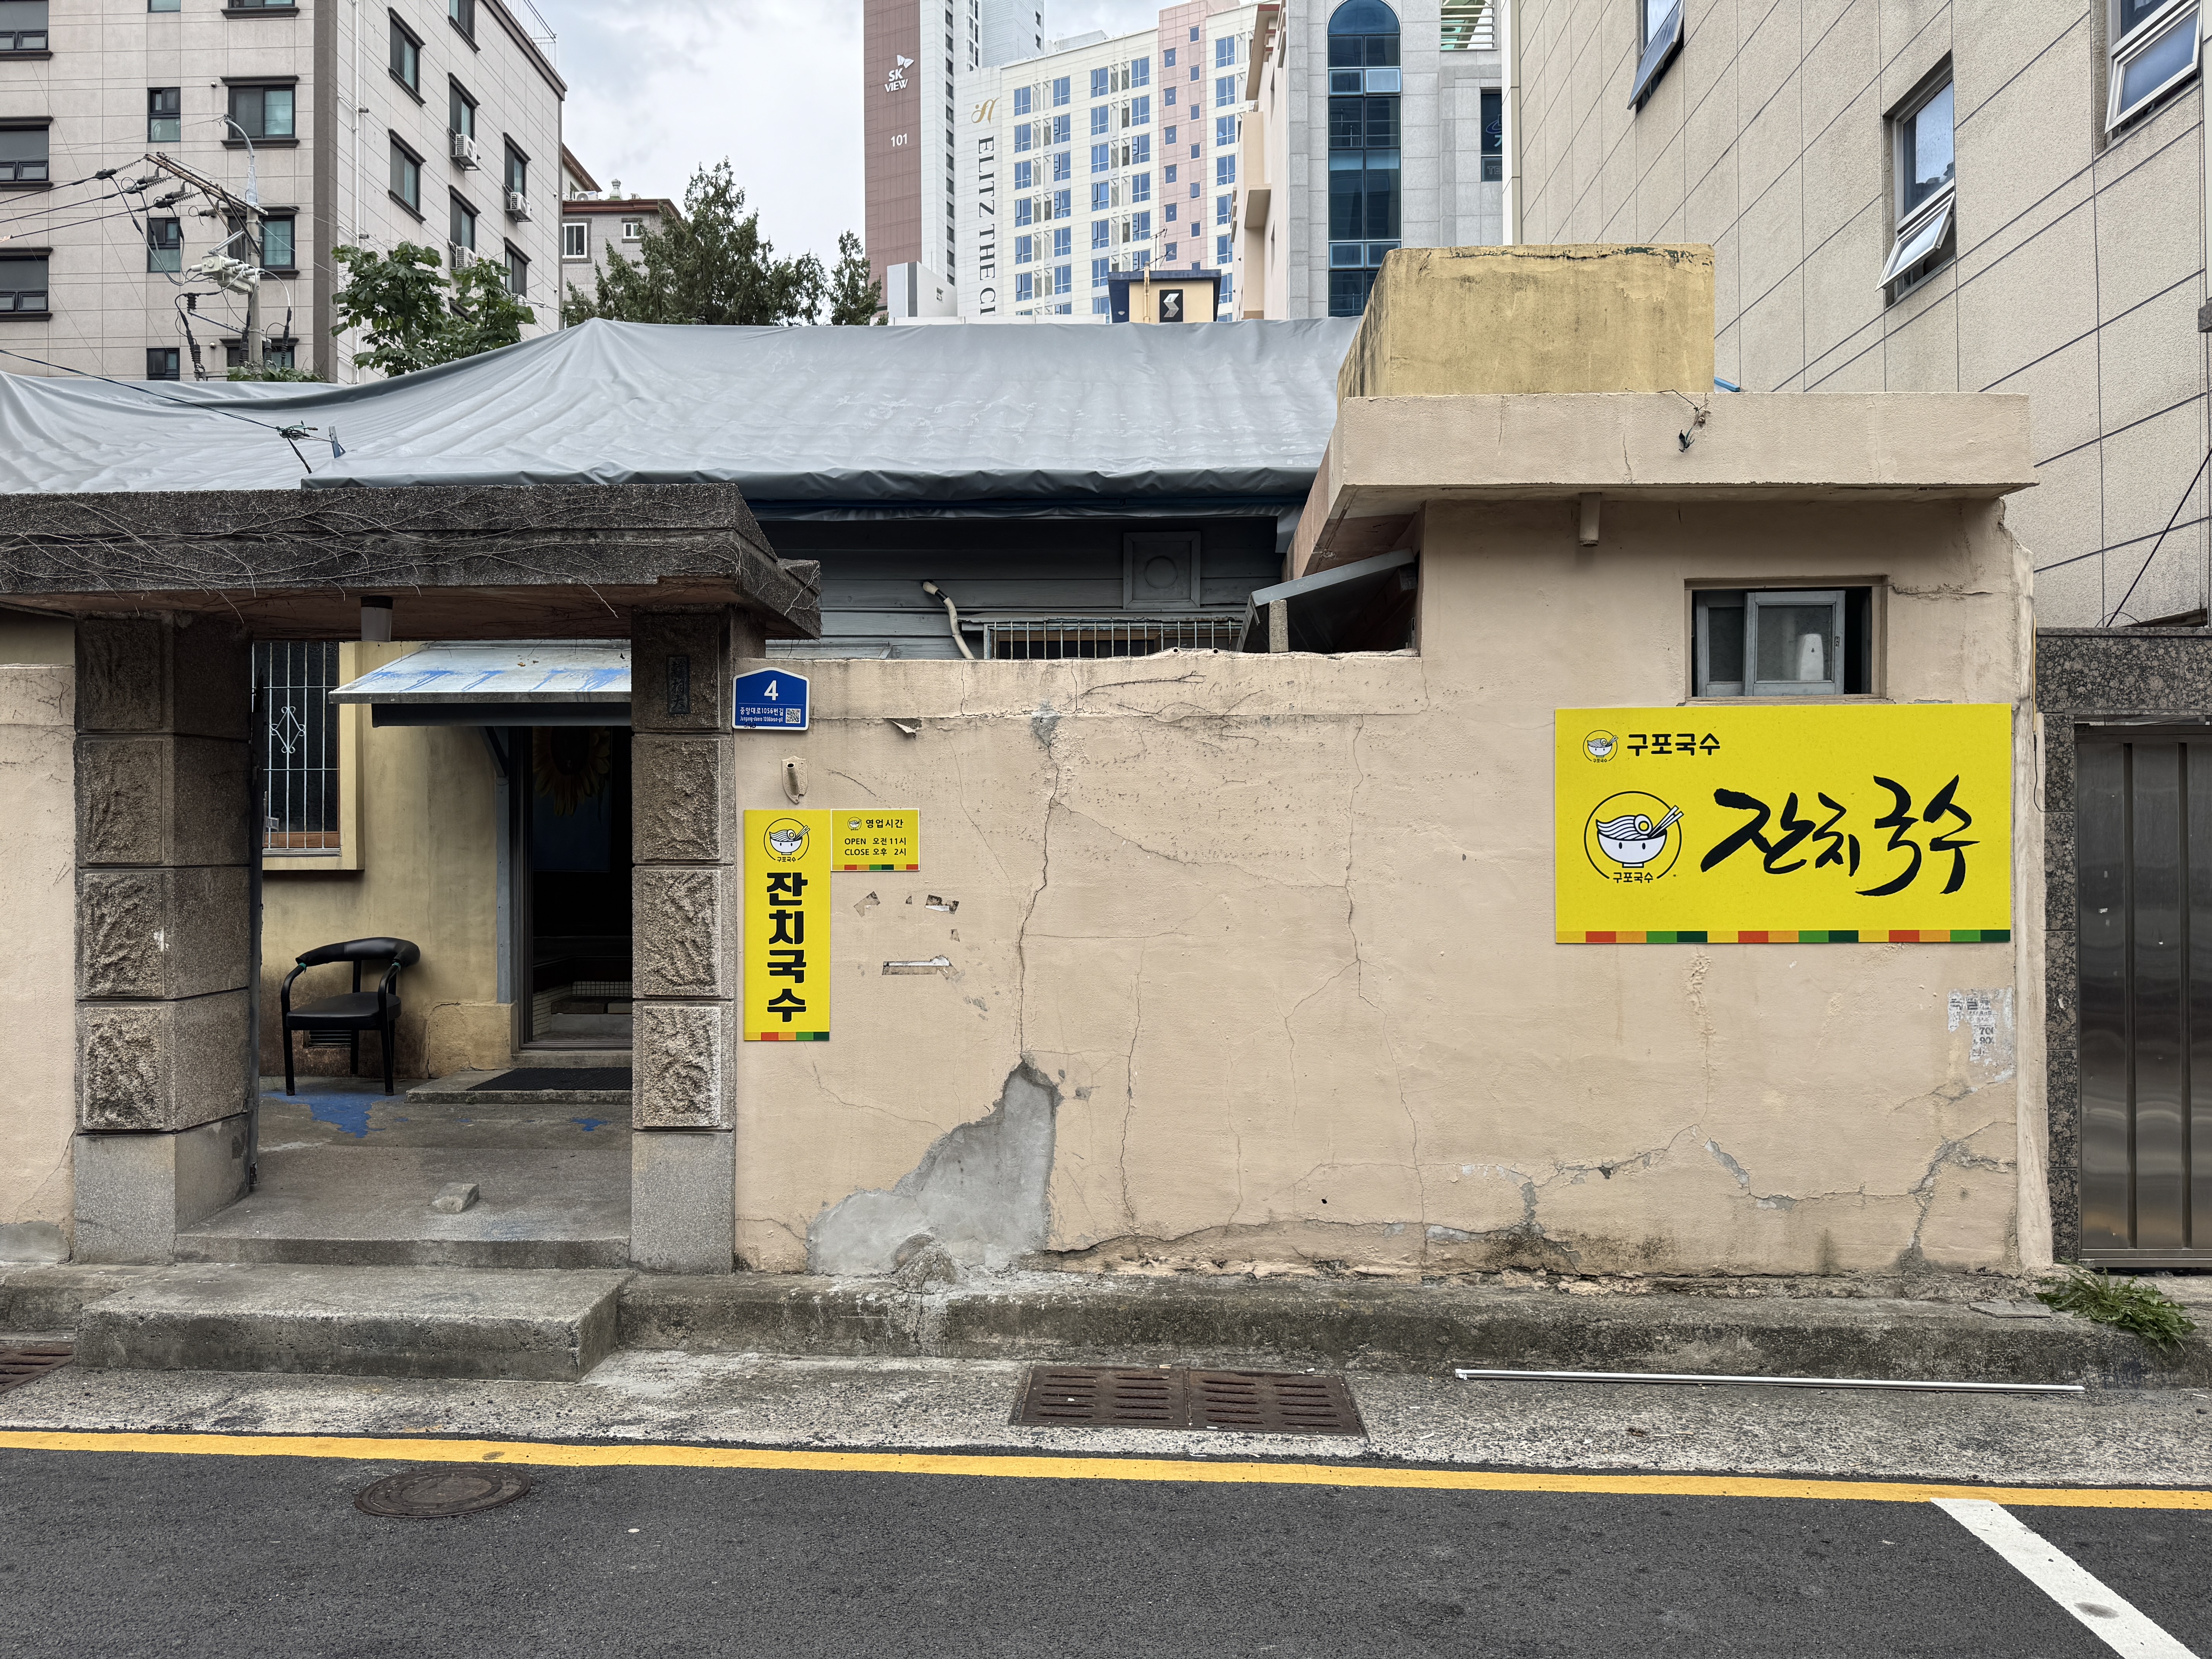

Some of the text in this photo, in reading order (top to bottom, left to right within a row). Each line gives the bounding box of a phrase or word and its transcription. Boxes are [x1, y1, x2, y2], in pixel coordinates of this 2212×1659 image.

[889, 68, 903, 82] SK
[884, 79, 908, 93] VIEW
[891, 133, 907, 147] 101
[979, 135, 994, 218] ELITZ
[979, 223, 995, 280] THE
[764, 680, 778, 701] 4
[740, 707, 783, 716] 중앙대로1056번길
[1627, 733, 1720, 756] 구포국수
[866, 819, 903, 828] 영업시간
[1700, 774, 1980, 896] 잔치국수
[894, 848, 906, 856] 2시
[1613, 872, 1654, 883] 구포국수
[766, 872, 808, 1022] 잔치국수
